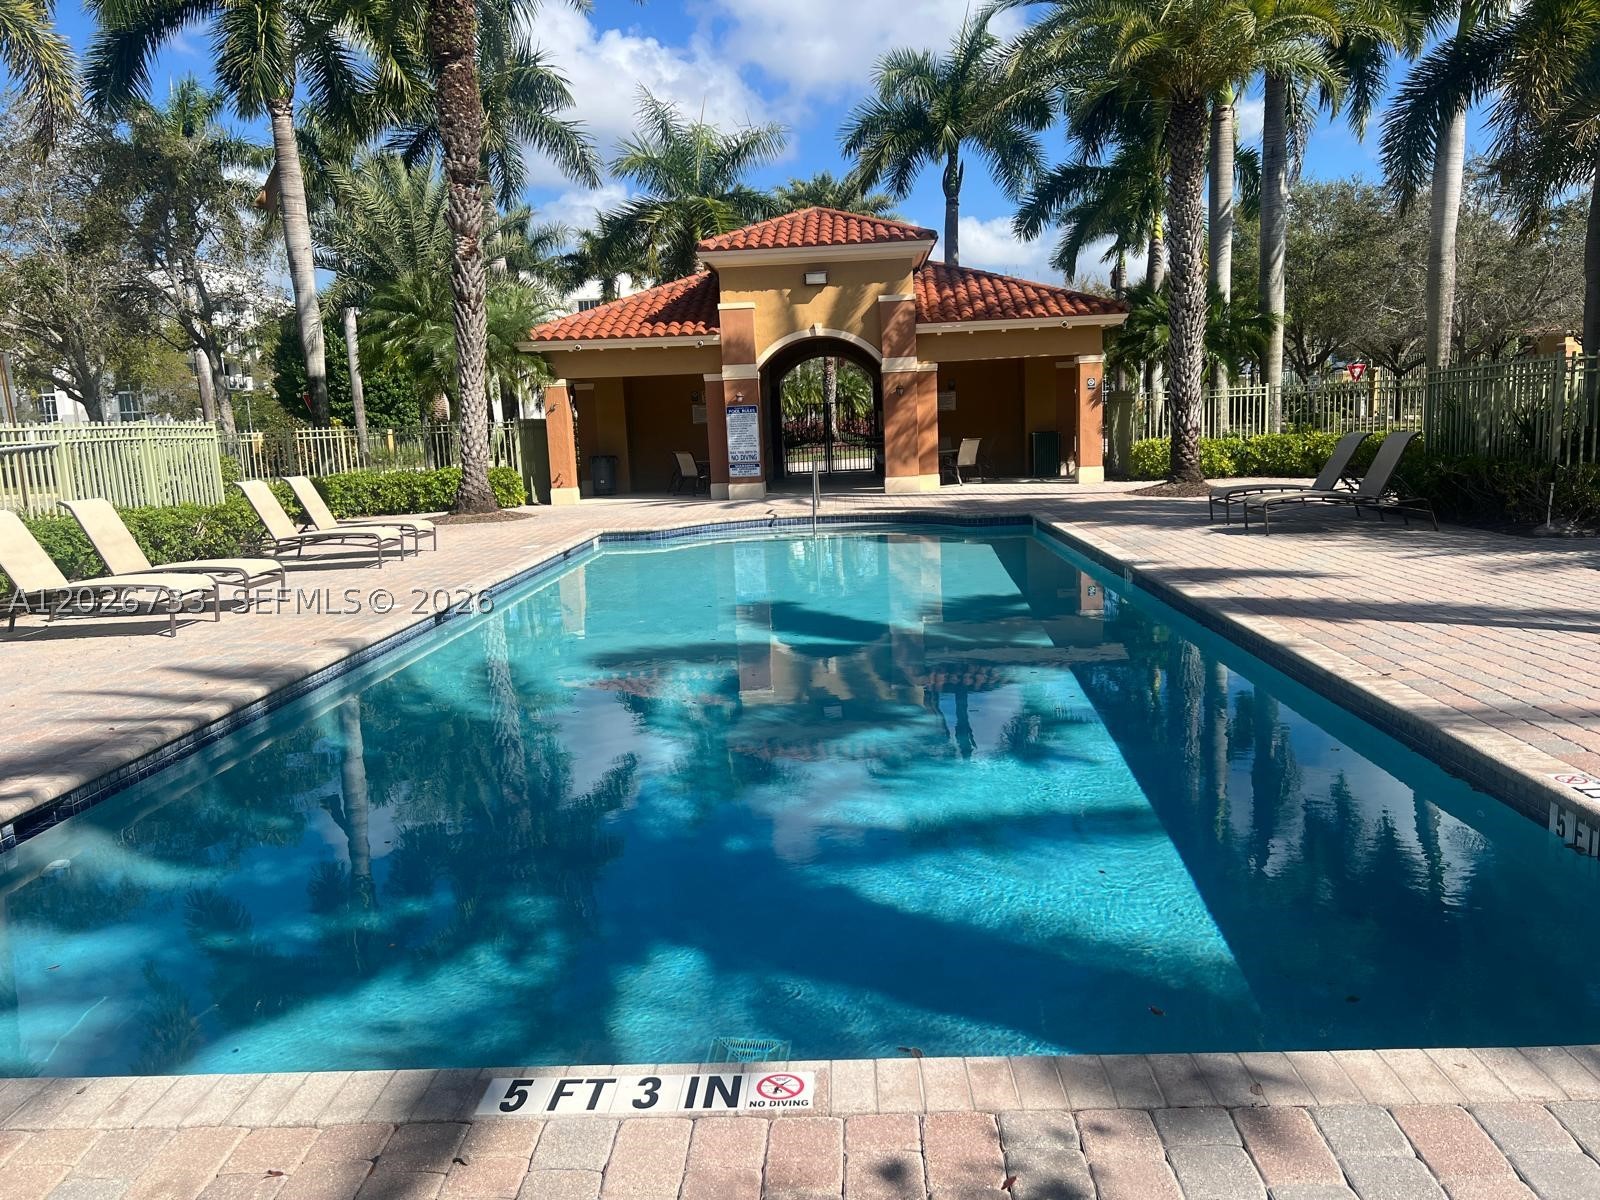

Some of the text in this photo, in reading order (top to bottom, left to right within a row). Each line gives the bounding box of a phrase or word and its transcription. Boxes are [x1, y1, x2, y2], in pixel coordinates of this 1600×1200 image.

[499, 1075, 743, 1112] 5 FT 3 IN
[749, 1099, 809, 1108] NO DIVING
